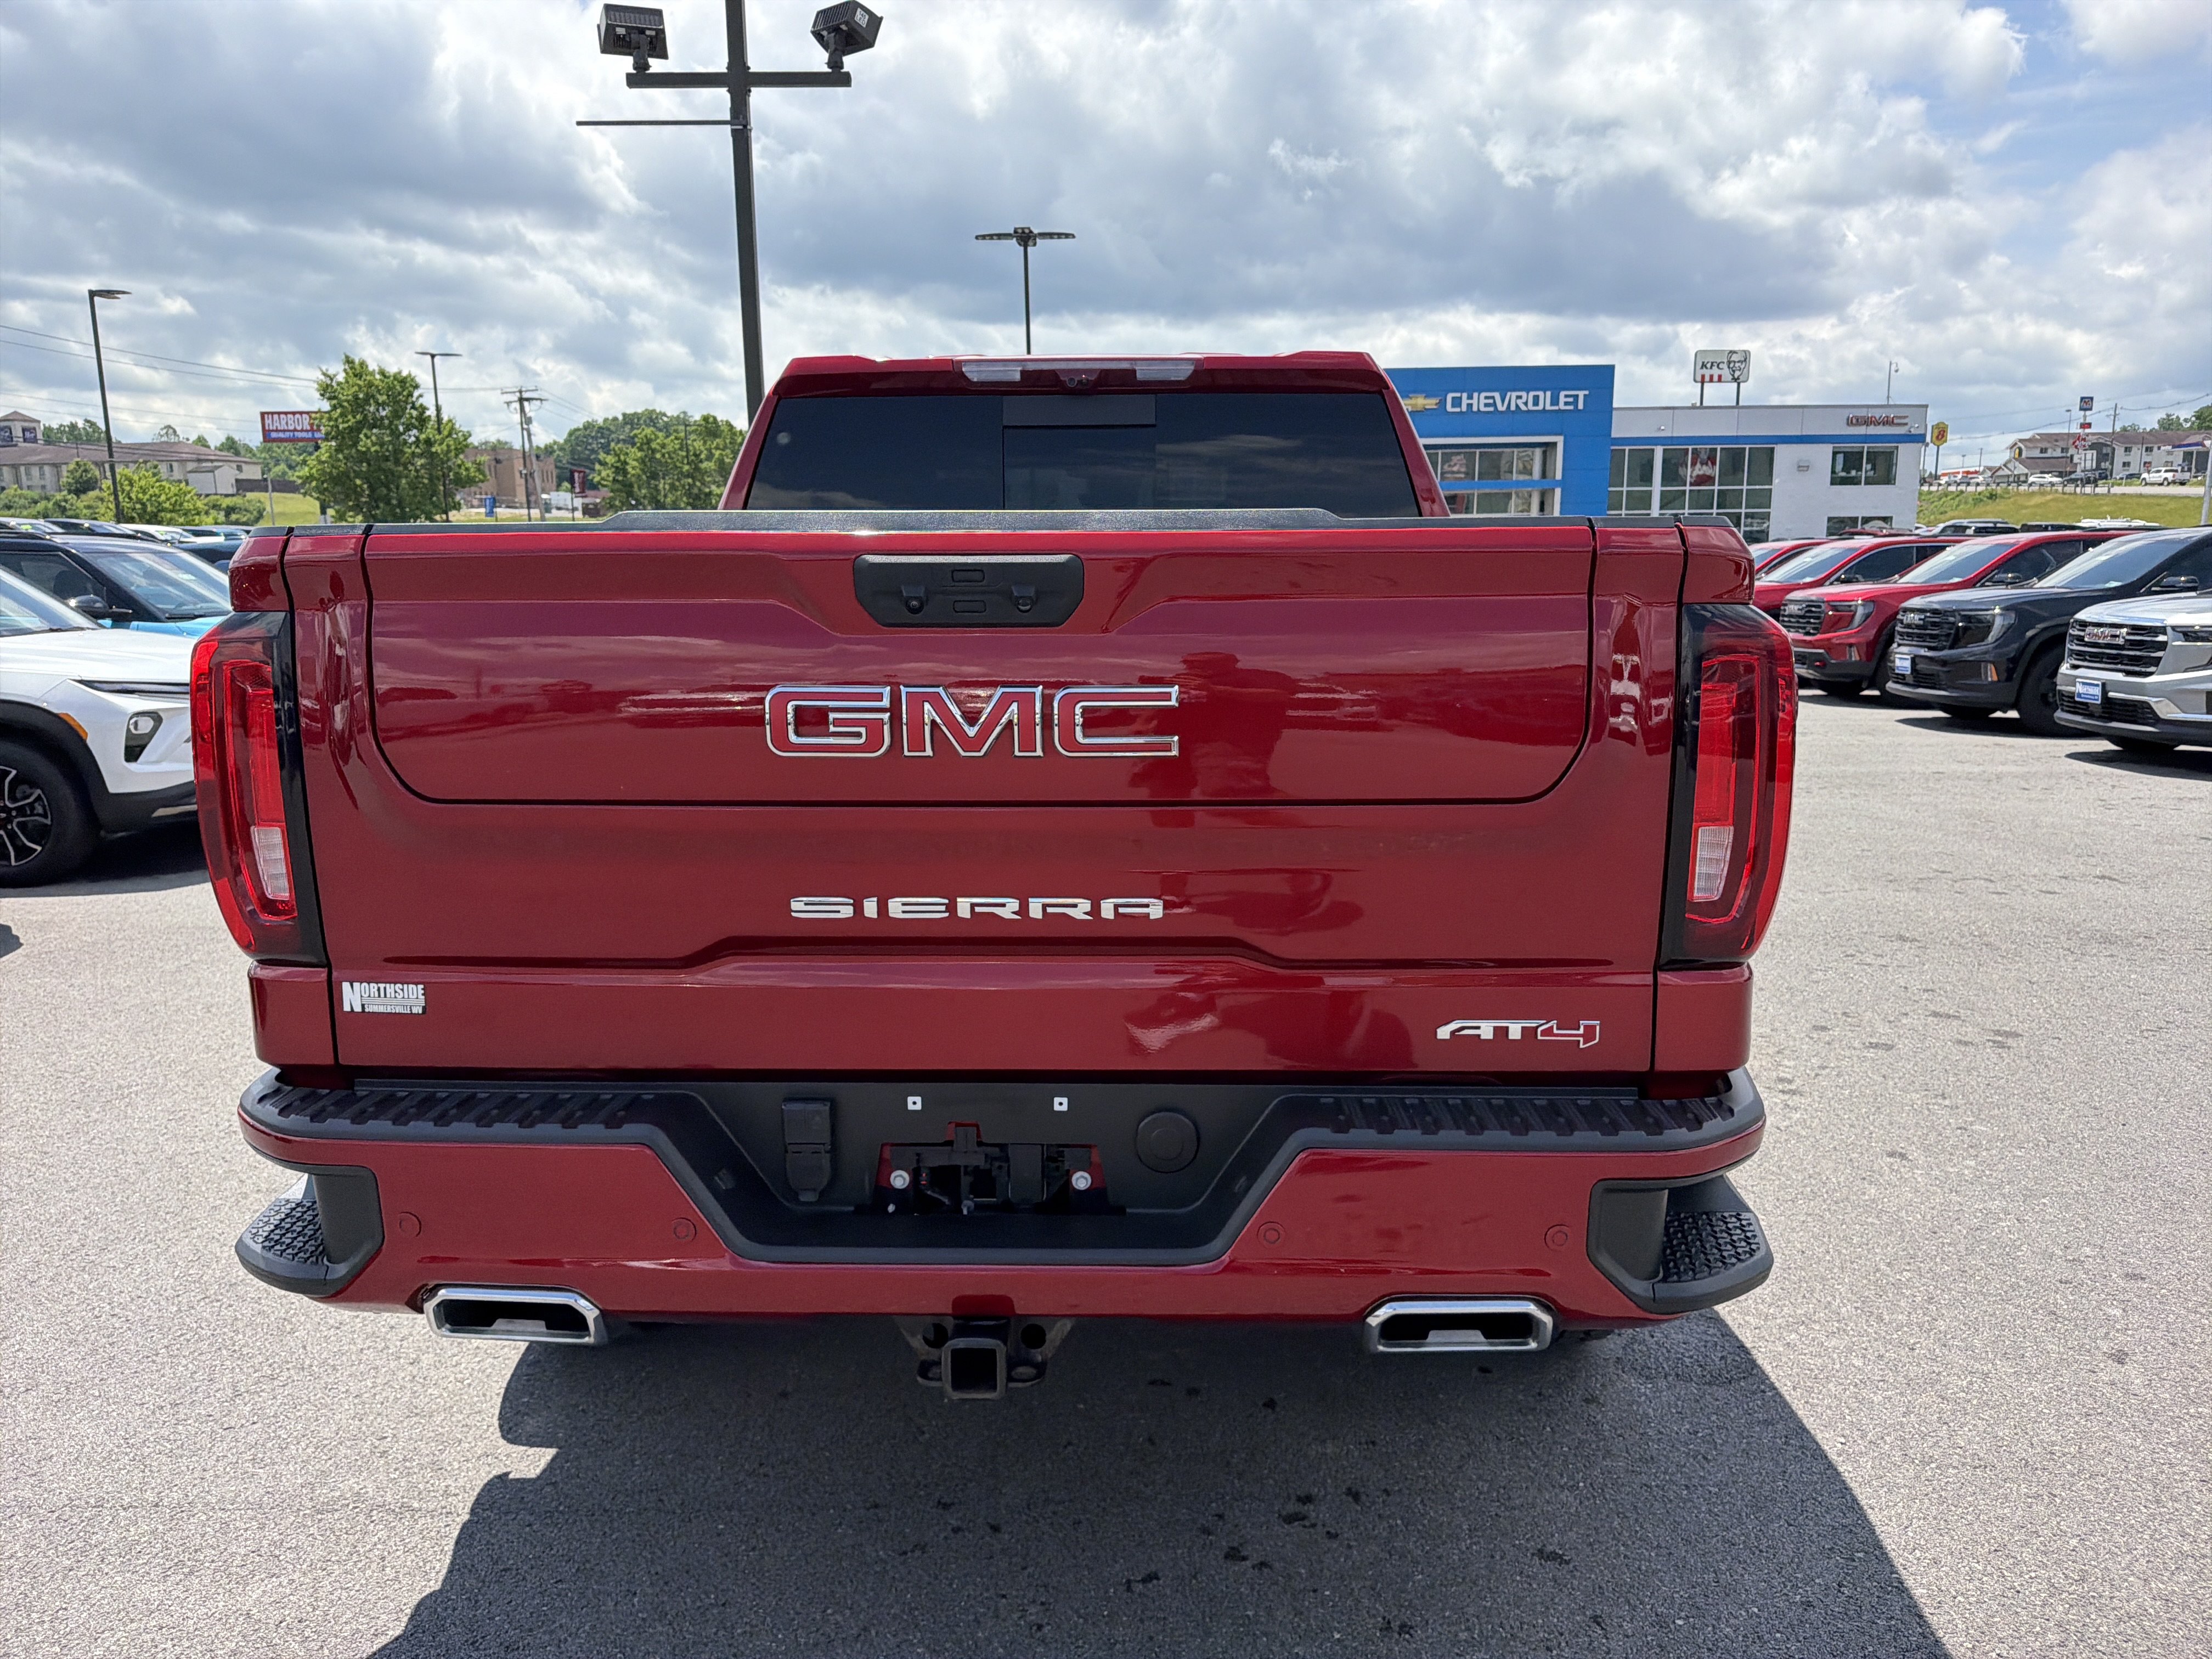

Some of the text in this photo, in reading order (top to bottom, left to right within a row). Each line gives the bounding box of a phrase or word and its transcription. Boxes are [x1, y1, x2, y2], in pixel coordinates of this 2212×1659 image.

[856, 14, 866, 25] LED
[1700, 360, 1725, 370] KFC
[1446, 390, 1589, 412] CHEVROLET
[264, 413, 311, 431] HARBOR
[1848, 414, 1909, 426] GMC
[1936, 430, 1946, 442] 8
[765, 685, 1180, 758] GMC
[790, 896, 1164, 920] SIERRA
[342, 981, 425, 1012] NORTHSIDE
[364, 1004, 422, 1014] SUMMERSVILLE WV
[1436, 1019, 1600, 1048] AT4
